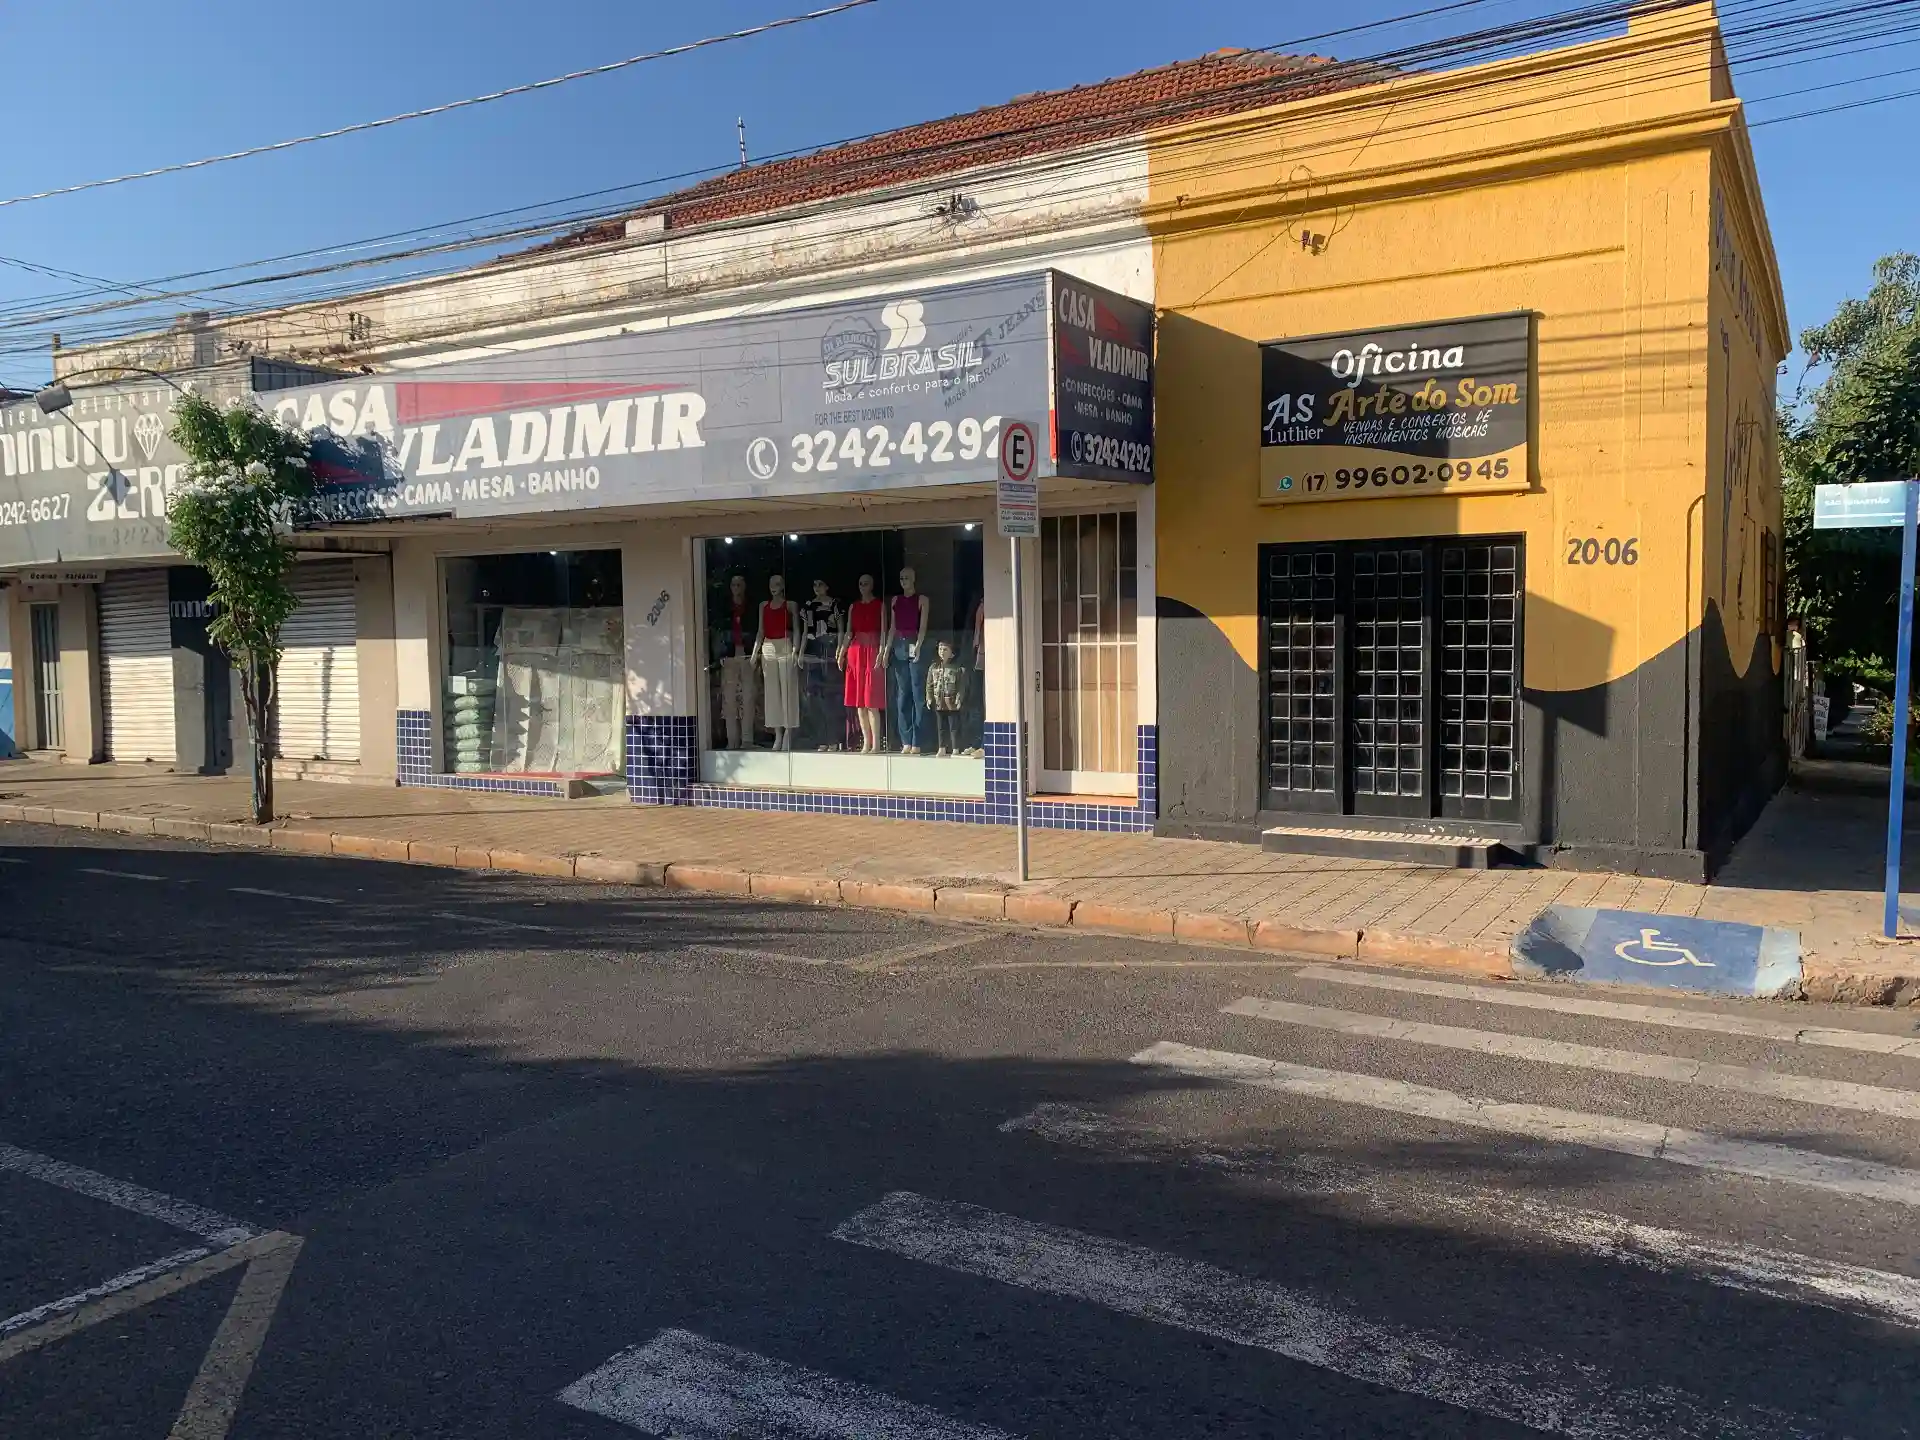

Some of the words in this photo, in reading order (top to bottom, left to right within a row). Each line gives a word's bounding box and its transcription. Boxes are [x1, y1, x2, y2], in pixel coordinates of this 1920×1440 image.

[1059, 288, 1096, 333] CASA
[822, 357, 877, 389] SUL
[879, 341, 983, 381] BRASIL
[1088, 336, 1149, 383] VLADIMIR
[1330, 343, 1465, 388] Oficina
[825, 388, 853, 405] Moda
[858, 391, 865, 399] e
[869, 380, 920, 398] conforto
[924, 378, 949, 395] para
[953, 377, 961, 385] o
[966, 371, 981, 385] lar
[1122, 393, 1143, 410] CAMA
[1322, 384, 1407, 427] Arte
[1411, 378, 1447, 412] do
[1454, 378, 1521, 408] Som
[274, 385, 393, 438] CASA
[814, 412, 829, 426] FOR
[843, 409, 860, 424] BEST
[1077, 400, 1098, 419] MESA
[1105, 407, 1133, 426] BANHO
[1343, 418, 1383, 434] VENDAS
[1388, 417, 1396, 431] E
[1401, 411, 1467, 430] CONSERTOS
[1476, 409, 1493, 423] DE
[376, 391, 707, 480] VLADIMIR
[1012, 434, 1025, 469] E
[1268, 425, 1324, 444] Luthier
[1344, 427, 1429, 445] INSTRUMENTOS
[1435, 423, 1489, 440] MUSICAIS
[404, 481, 453, 505] CAMA
[461, 479, 516, 501] MESA
[527, 466, 600, 493] BANHO
[1301, 471, 1329, 494] (17)
